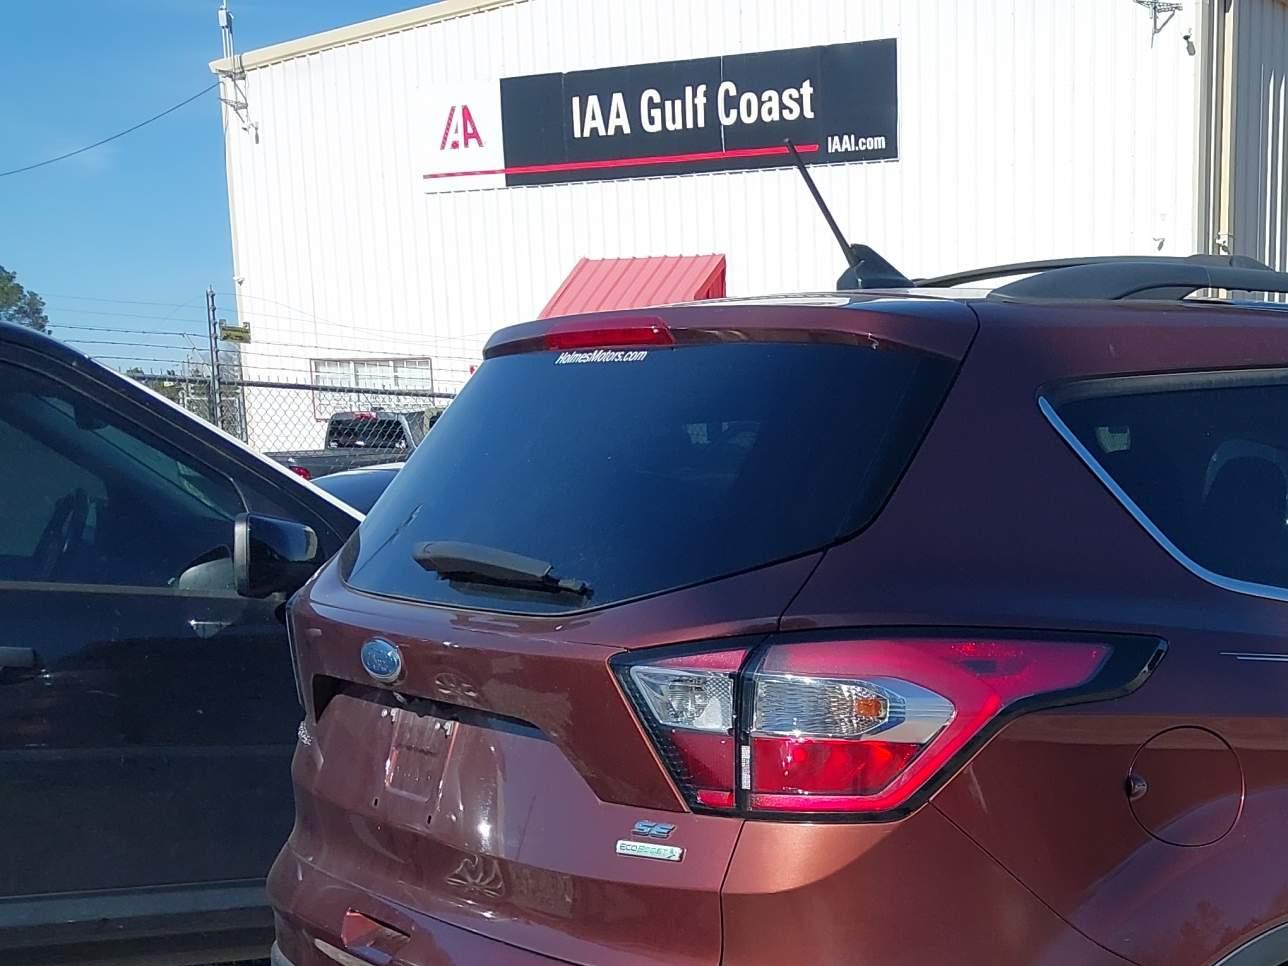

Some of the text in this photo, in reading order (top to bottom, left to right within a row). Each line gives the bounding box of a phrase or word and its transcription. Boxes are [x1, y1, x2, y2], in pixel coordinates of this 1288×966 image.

[572, 79, 815, 139] IAA Gulf Coast
[826, 134, 887, 153] IAAI.com
[554, 349, 648, 365] HolmesMotors.com
